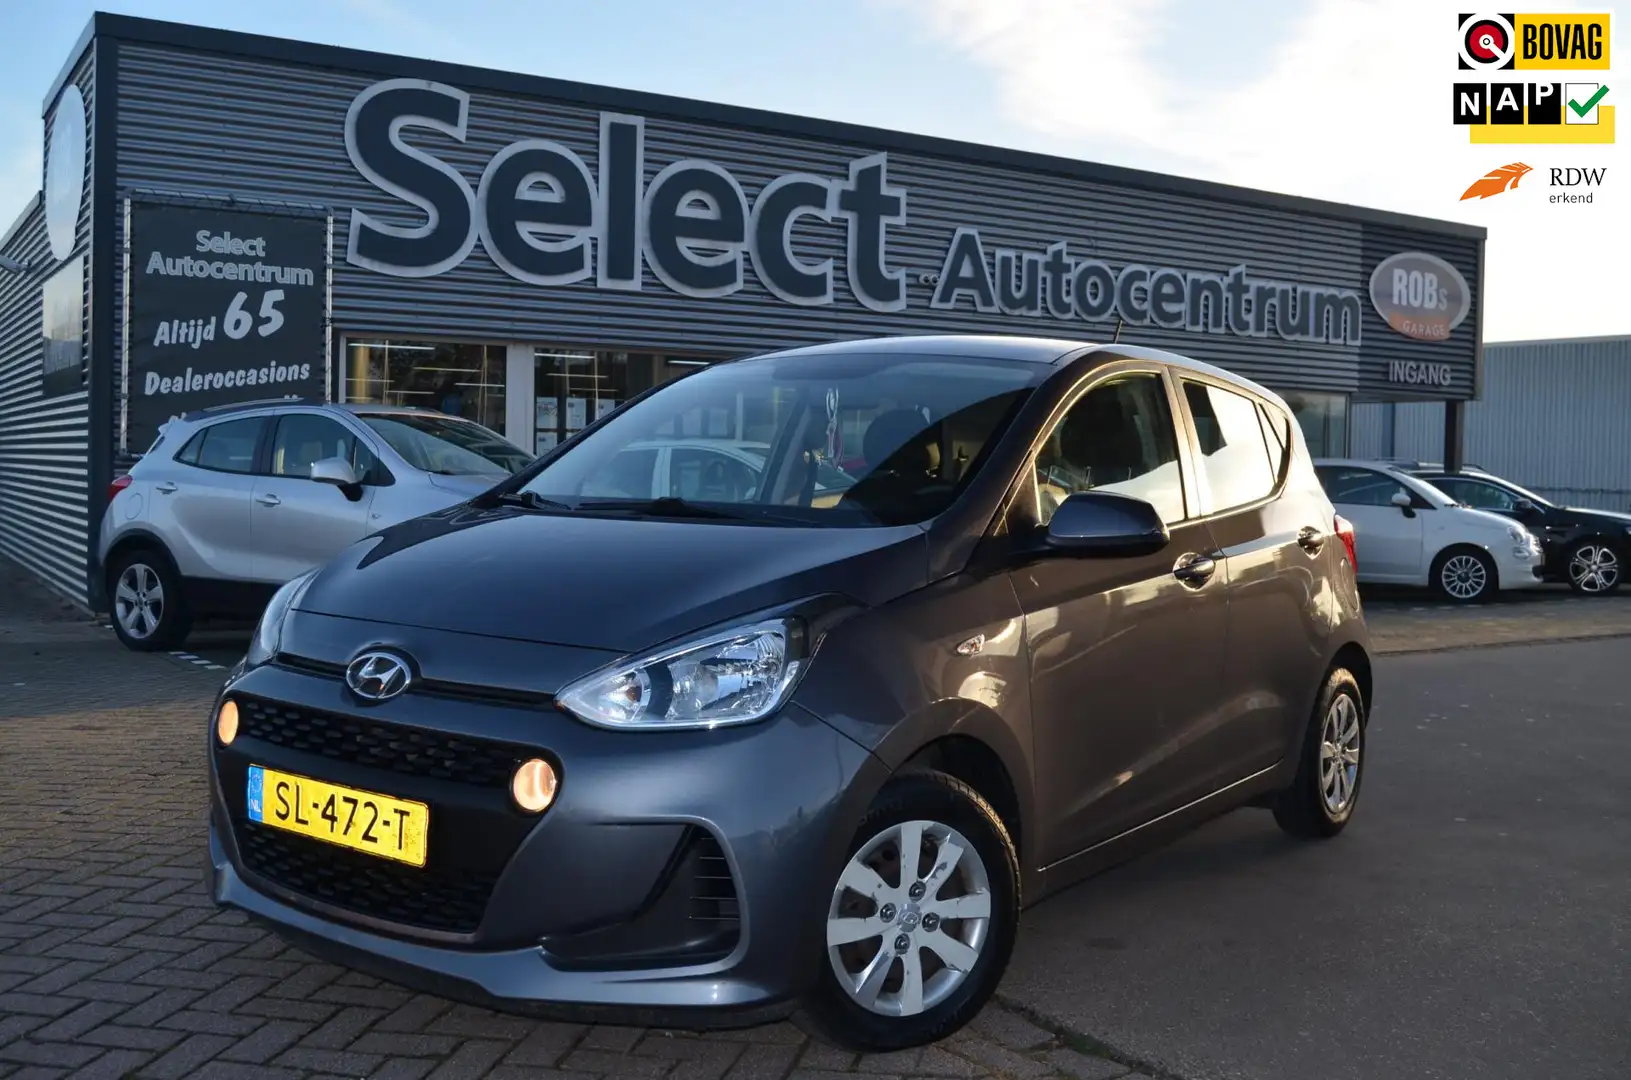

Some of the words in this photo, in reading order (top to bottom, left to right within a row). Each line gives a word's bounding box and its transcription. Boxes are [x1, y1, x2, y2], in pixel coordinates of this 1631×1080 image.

[344, 78, 906, 312] Select
[930, 227, 1362, 346] Autocentrum
[196, 230, 266, 257] Select
[146, 251, 314, 286] Autocentrum
[153, 316, 217, 349] Altijd
[223, 289, 285, 340] 65
[1402, 320, 1445, 336] GARAGE
[144, 360, 310, 395] Dealeroccasions
[1388, 361, 1451, 385] INGANG
[275, 781, 411, 850] SL-472-T
